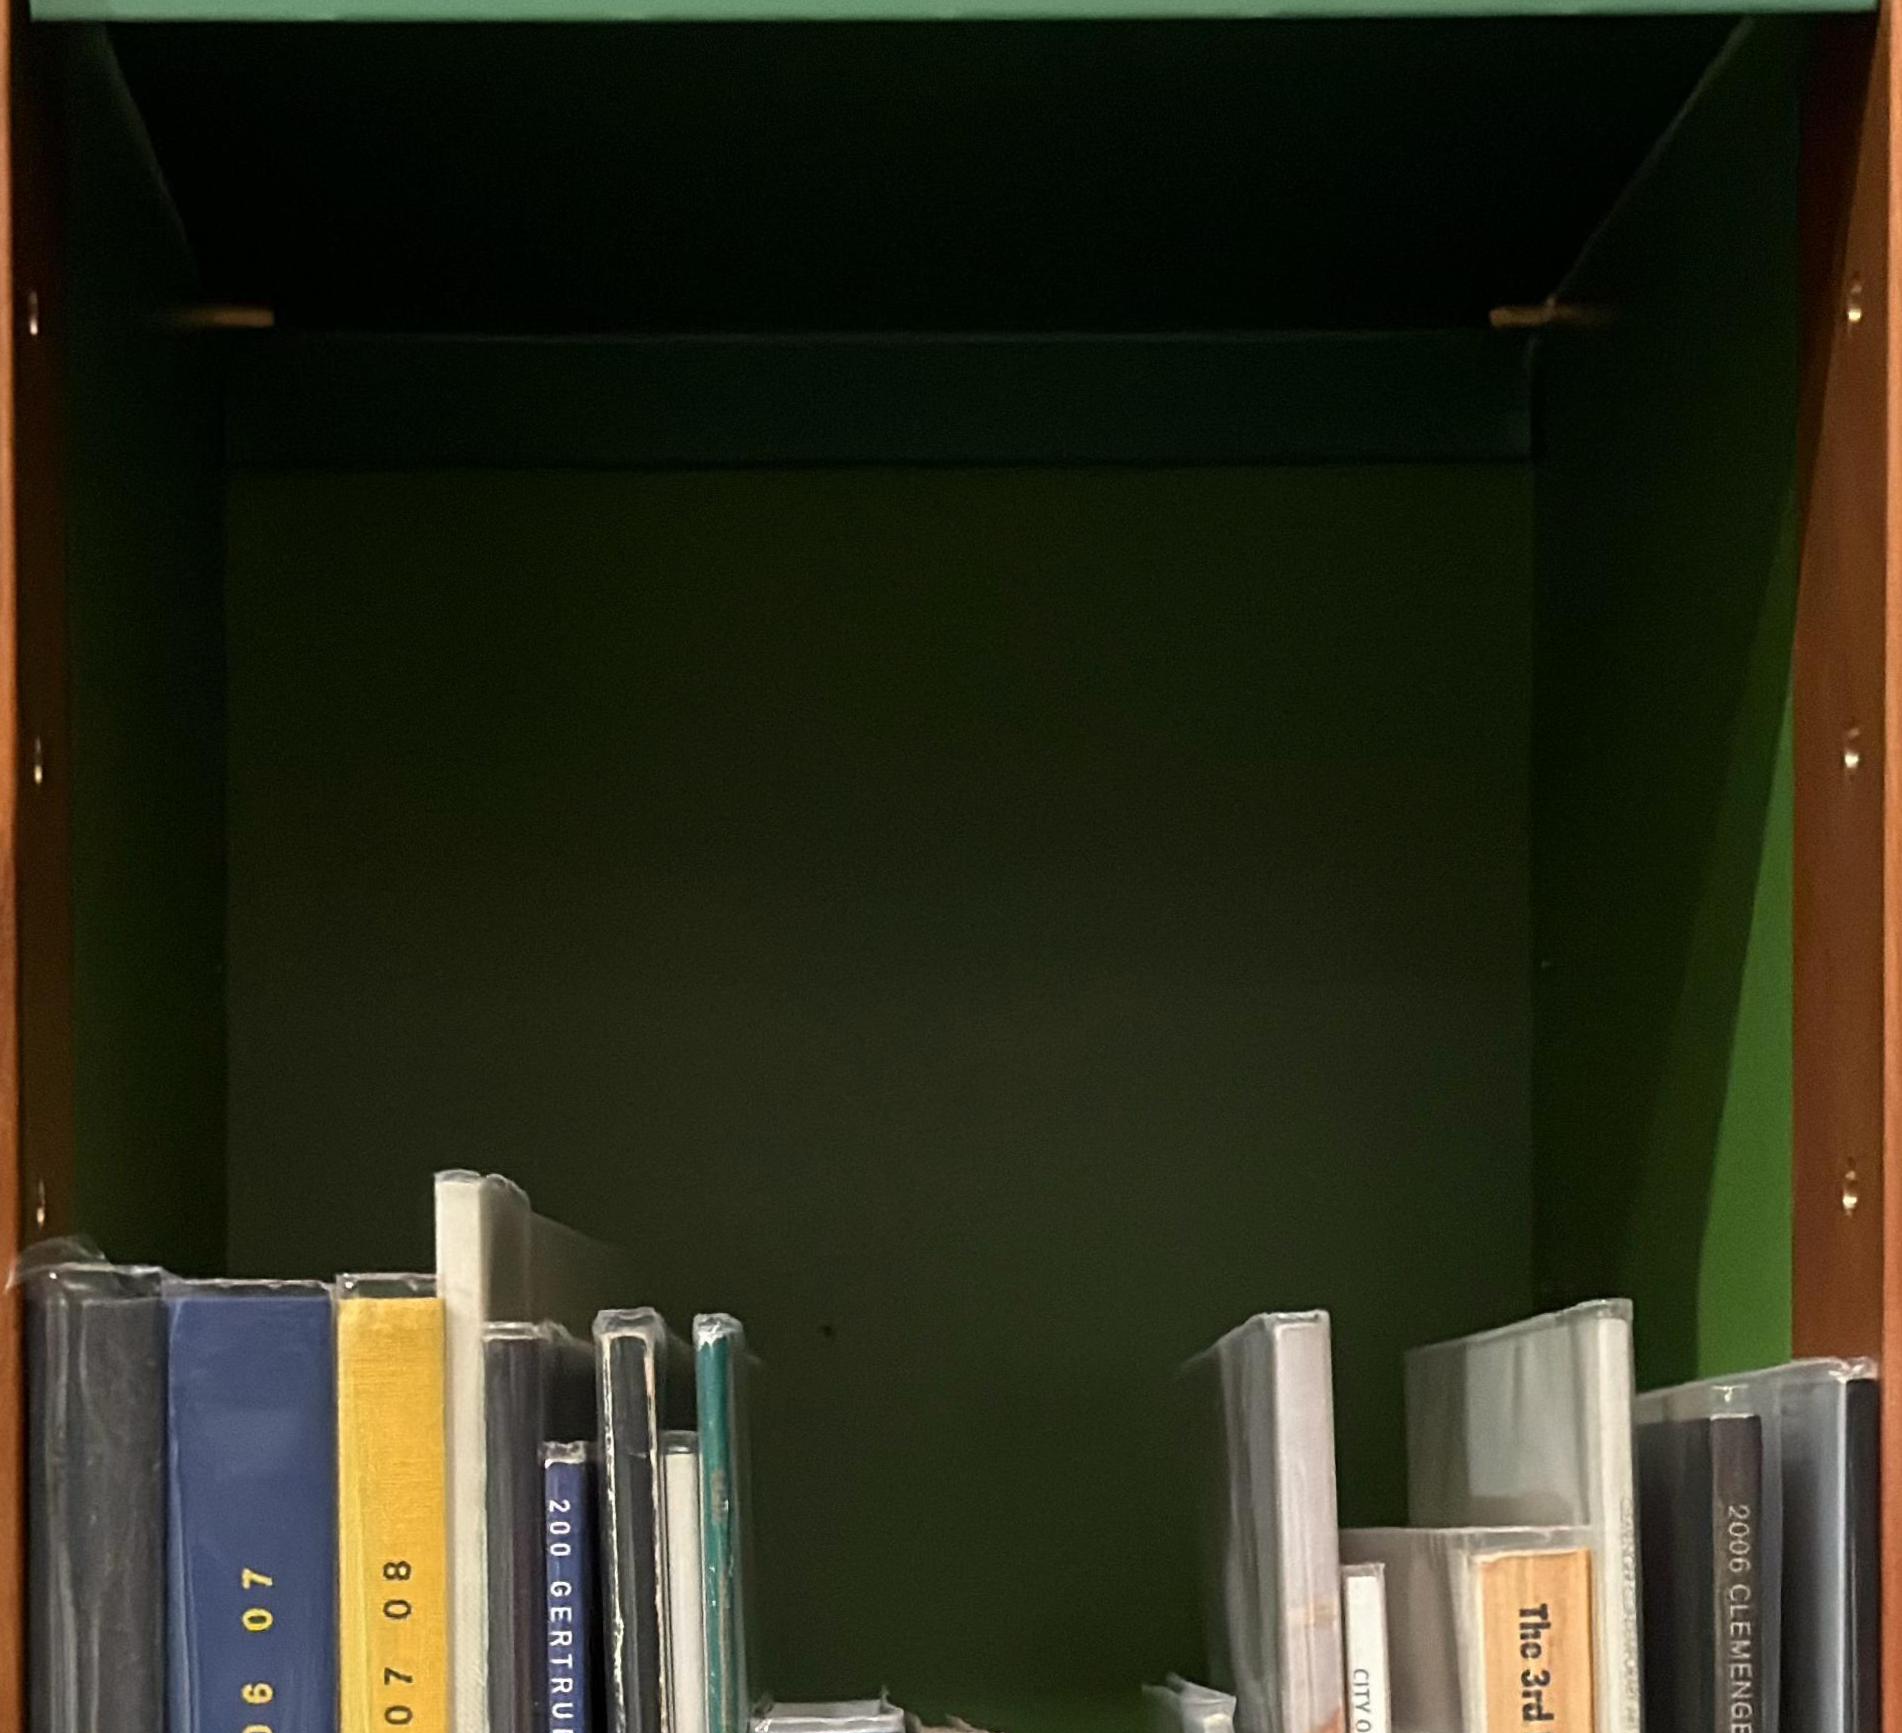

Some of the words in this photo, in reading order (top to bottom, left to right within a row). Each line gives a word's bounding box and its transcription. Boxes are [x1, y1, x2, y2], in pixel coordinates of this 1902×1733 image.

[549, 1500, 571, 1557] 200
[1728, 1504, 1750, 1573] 2006
[241, 1569, 274, 1631] 07
[382, 1560, 412, 1620] 08
[1520, 1603, 1550, 1659] The
[383, 1667, 413, 1725] 07
[1353, 1669, 1370, 1713] CITY
[1521, 1669, 1553, 1722] 3rd
